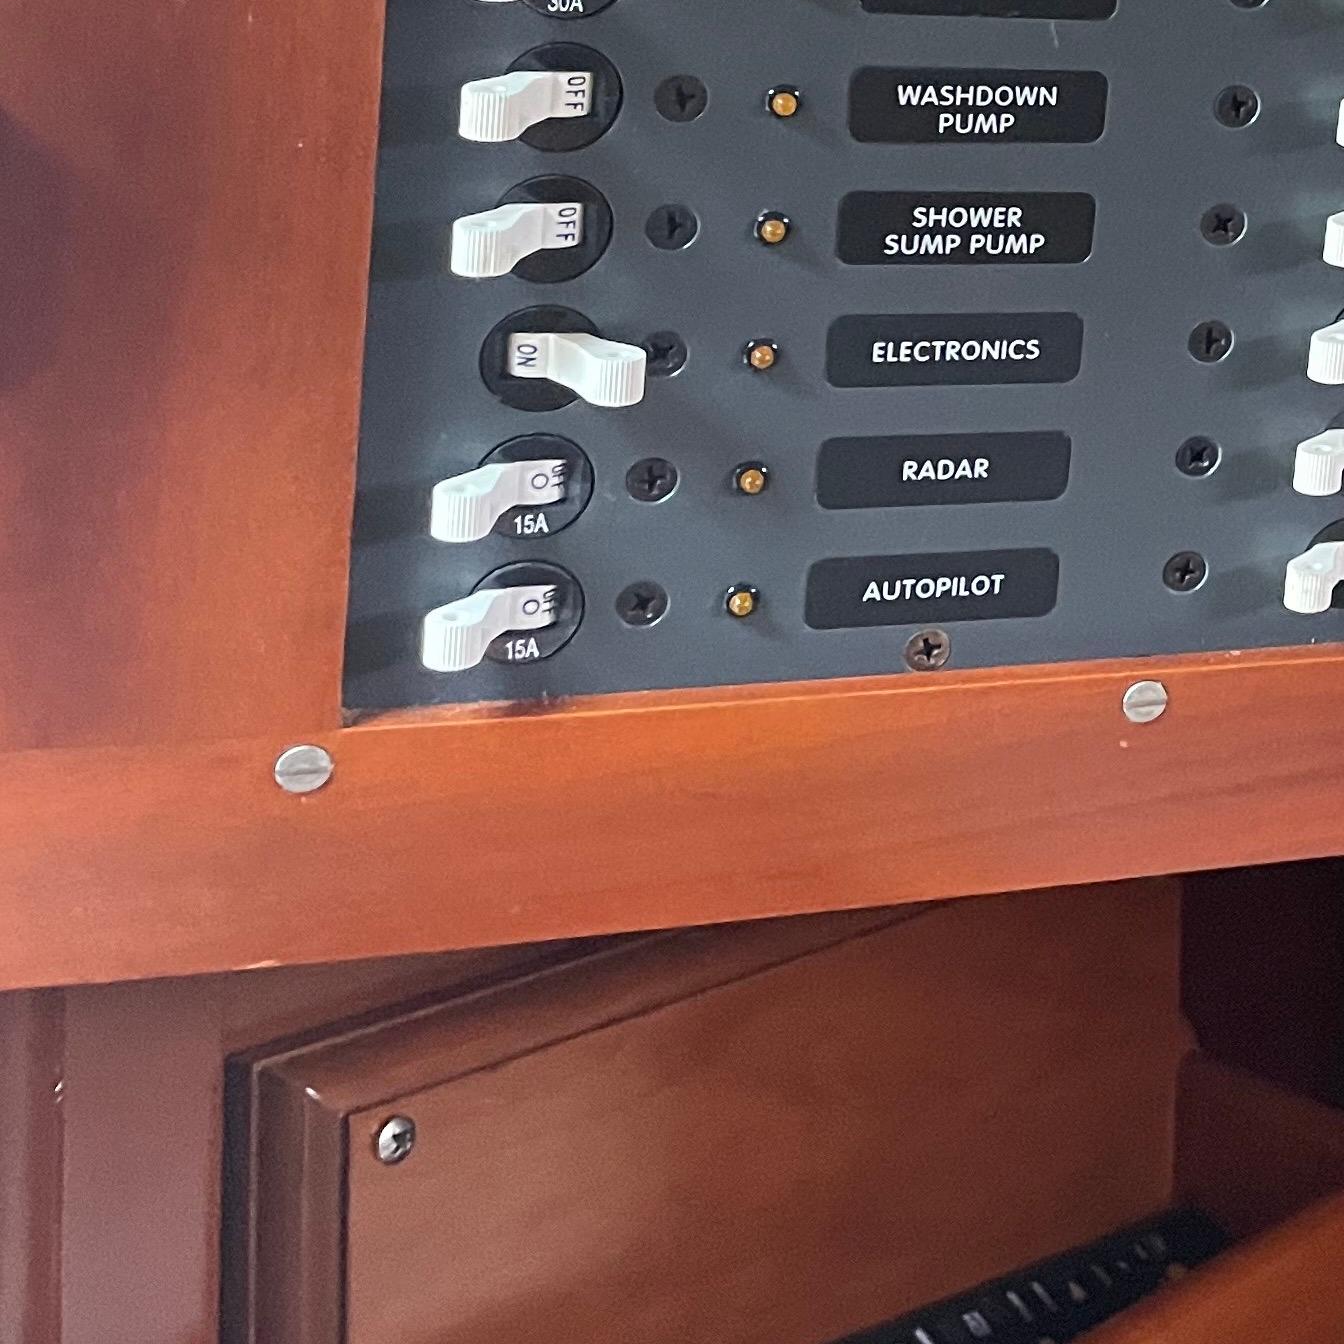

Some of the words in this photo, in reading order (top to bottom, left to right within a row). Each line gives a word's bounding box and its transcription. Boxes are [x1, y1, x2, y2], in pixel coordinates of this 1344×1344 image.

[566, 75, 586, 112] OFF
[897, 85, 1058, 107] WASHDOWN
[938, 112, 1015, 135] PUMP
[556, 206, 576, 245] OFF
[912, 206, 1023, 229] SHOWER
[883, 234, 961, 257] SUMP
[968, 233, 1046, 255] PUMP
[516, 344, 537, 368] ON
[871, 339, 1041, 364] ELECTRONICS
[901, 458, 989, 482] RADAR
[514, 513, 549, 535] 15A
[861, 573, 1005, 603] AUTOPILOT
[505, 638, 540, 660] 15A
